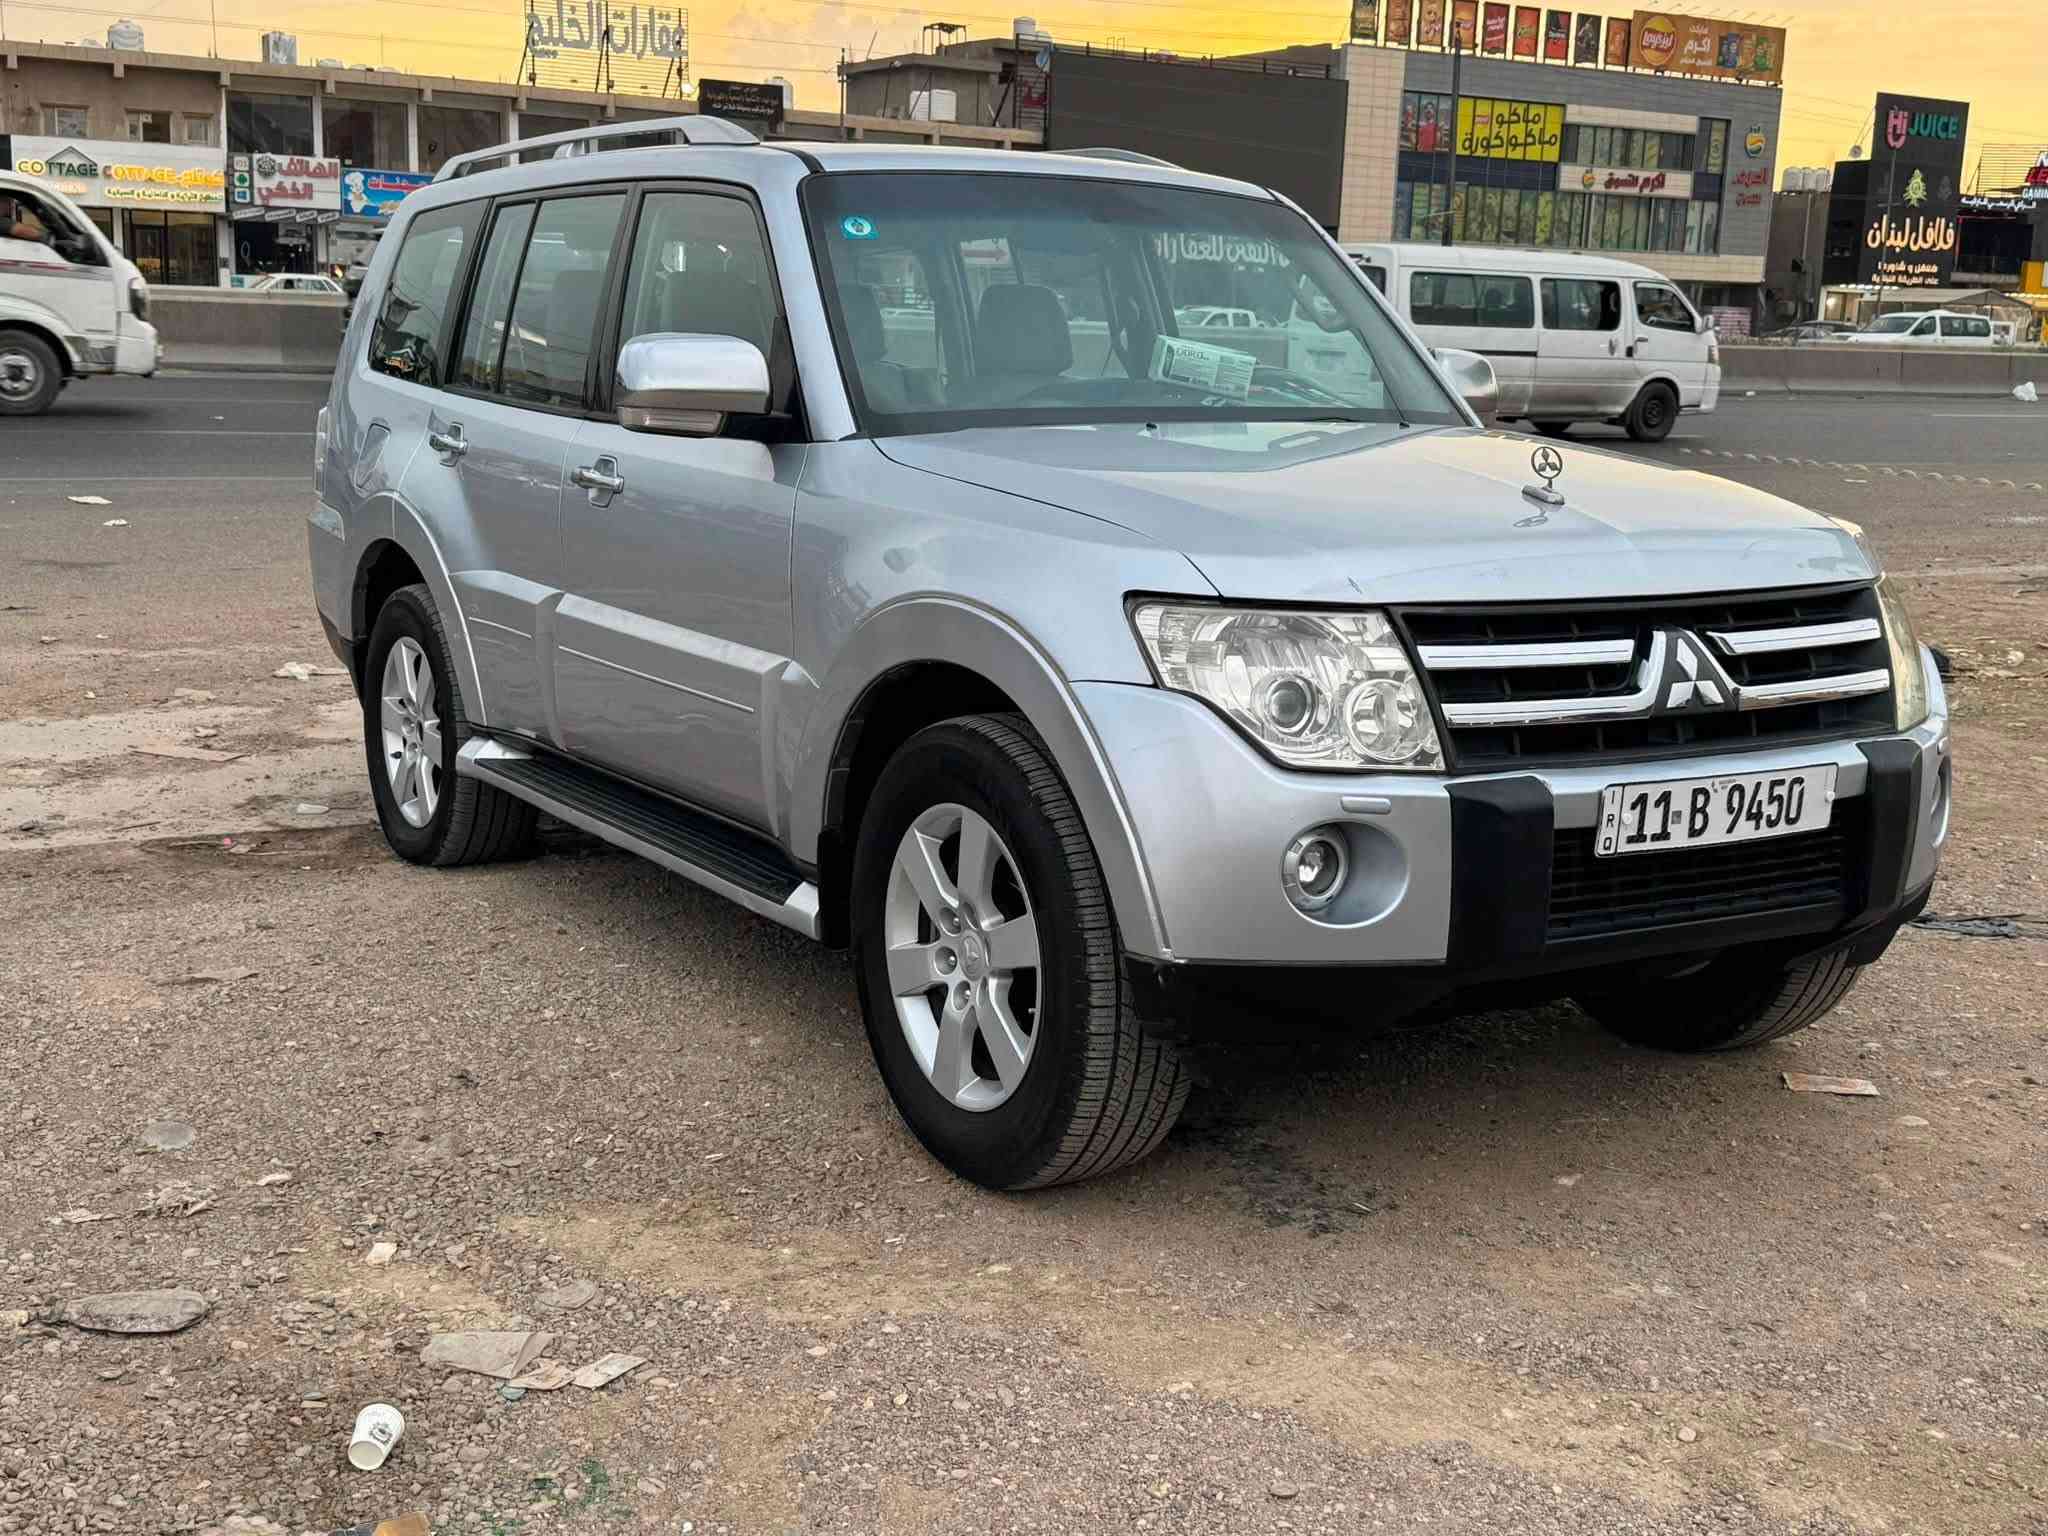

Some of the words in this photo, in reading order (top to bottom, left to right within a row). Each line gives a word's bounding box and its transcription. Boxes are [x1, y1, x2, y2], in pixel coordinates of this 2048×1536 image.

[1495, 107, 1542, 129] ماكو
[1908, 112, 1959, 139] JUICE
[18, 160, 99, 177] COTTAGE
[1867, 214, 1911, 252] لبنان
[1909, 216, 1955, 251] فلافل
[1626, 790, 1673, 844] 11
[1688, 786, 1711, 839] B
[1725, 776, 1806, 834] 9450
